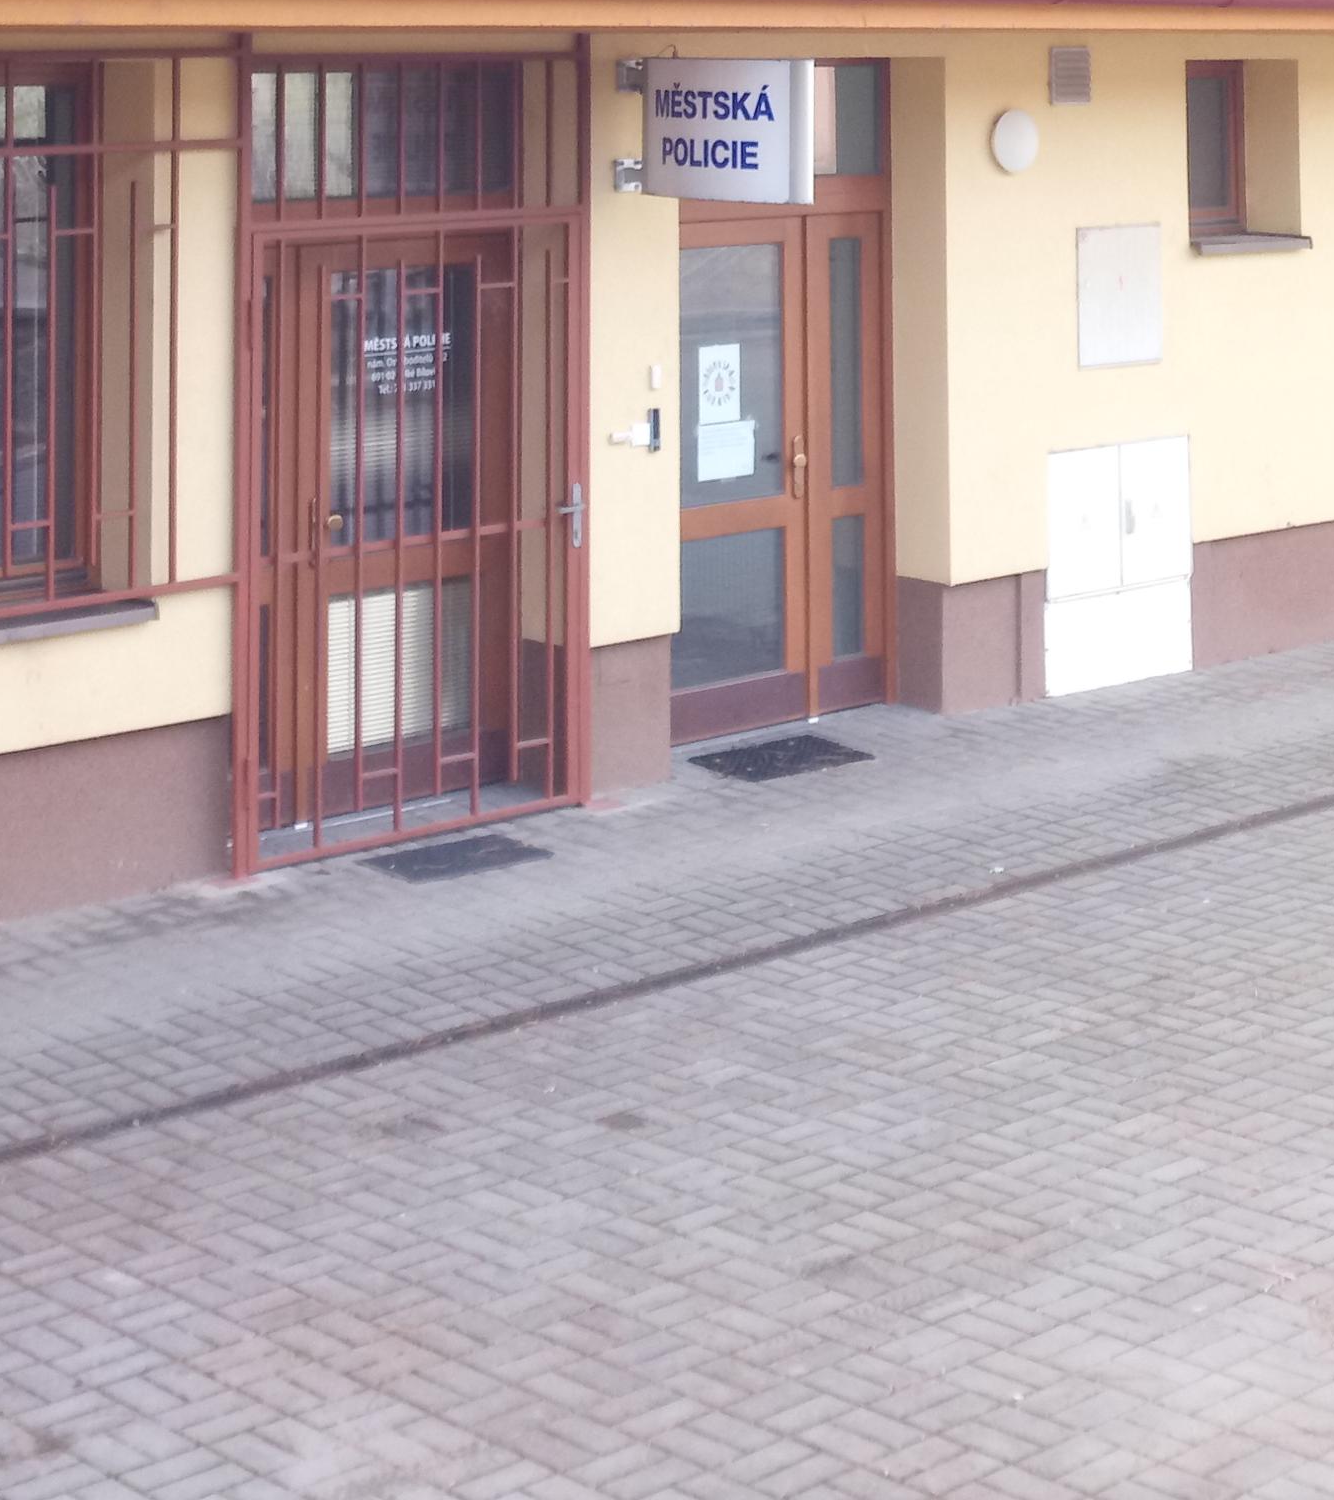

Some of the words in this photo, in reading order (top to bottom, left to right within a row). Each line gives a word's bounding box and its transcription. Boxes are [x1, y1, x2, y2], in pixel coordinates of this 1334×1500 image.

[655, 82, 775, 121] MĚSTSKÁ
[661, 137, 759, 170] POLICIE
[364, 334, 411, 352] MĚSTSÁ
[413, 332, 451, 348] POLIIE
